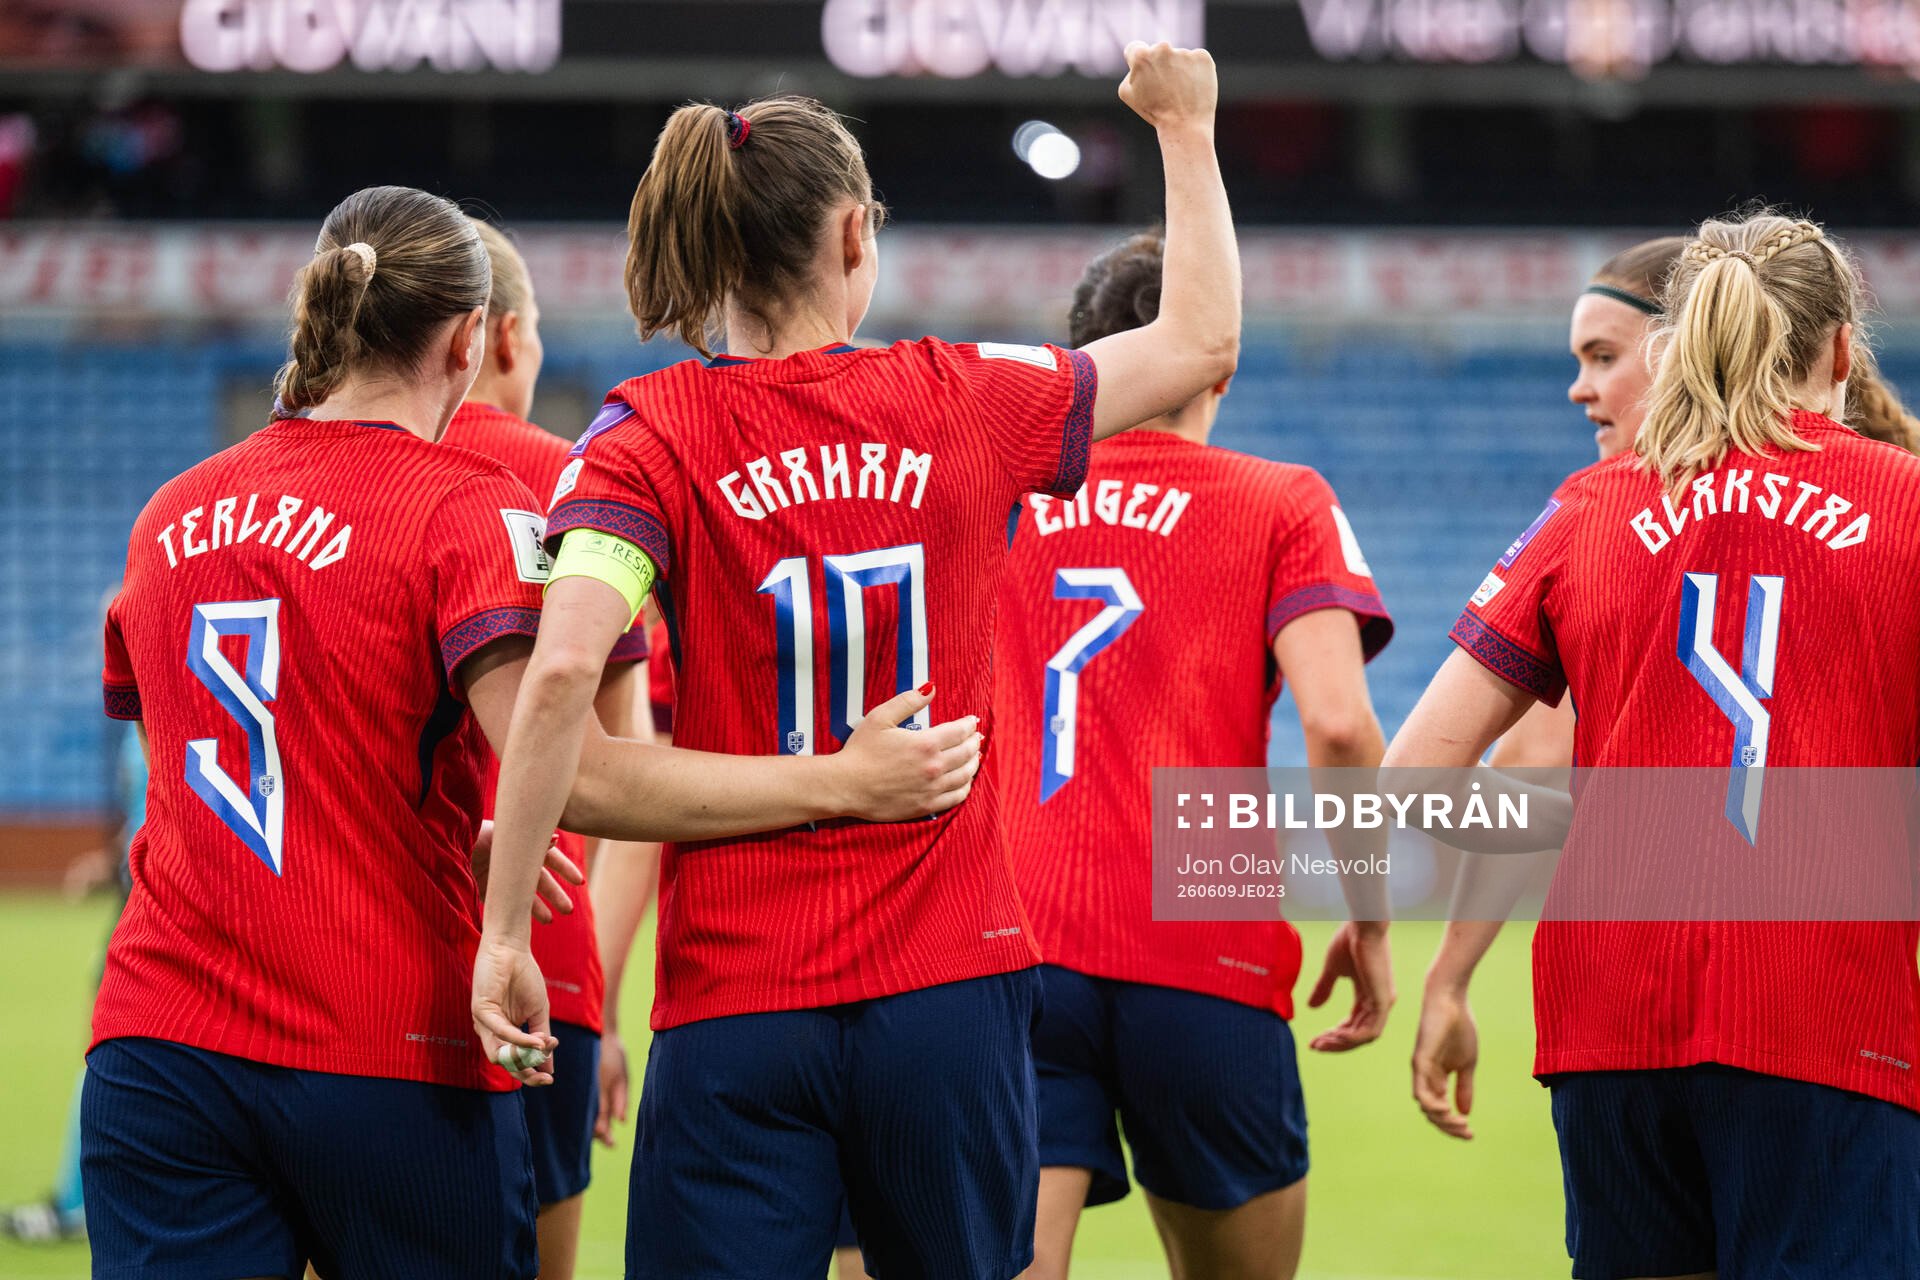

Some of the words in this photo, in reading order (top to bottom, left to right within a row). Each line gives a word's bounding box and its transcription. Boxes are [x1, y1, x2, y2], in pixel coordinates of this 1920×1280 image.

[716, 442, 933, 521] GRAHAM
[1028, 478, 1192, 538] ENGEN
[1629, 465, 1871, 555] BLAKSTAD
[156, 493, 353, 571] TERLAND
[756, 541, 939, 826] 10
[1038, 566, 1145, 805] 7
[1676, 571, 1786, 848] 4
